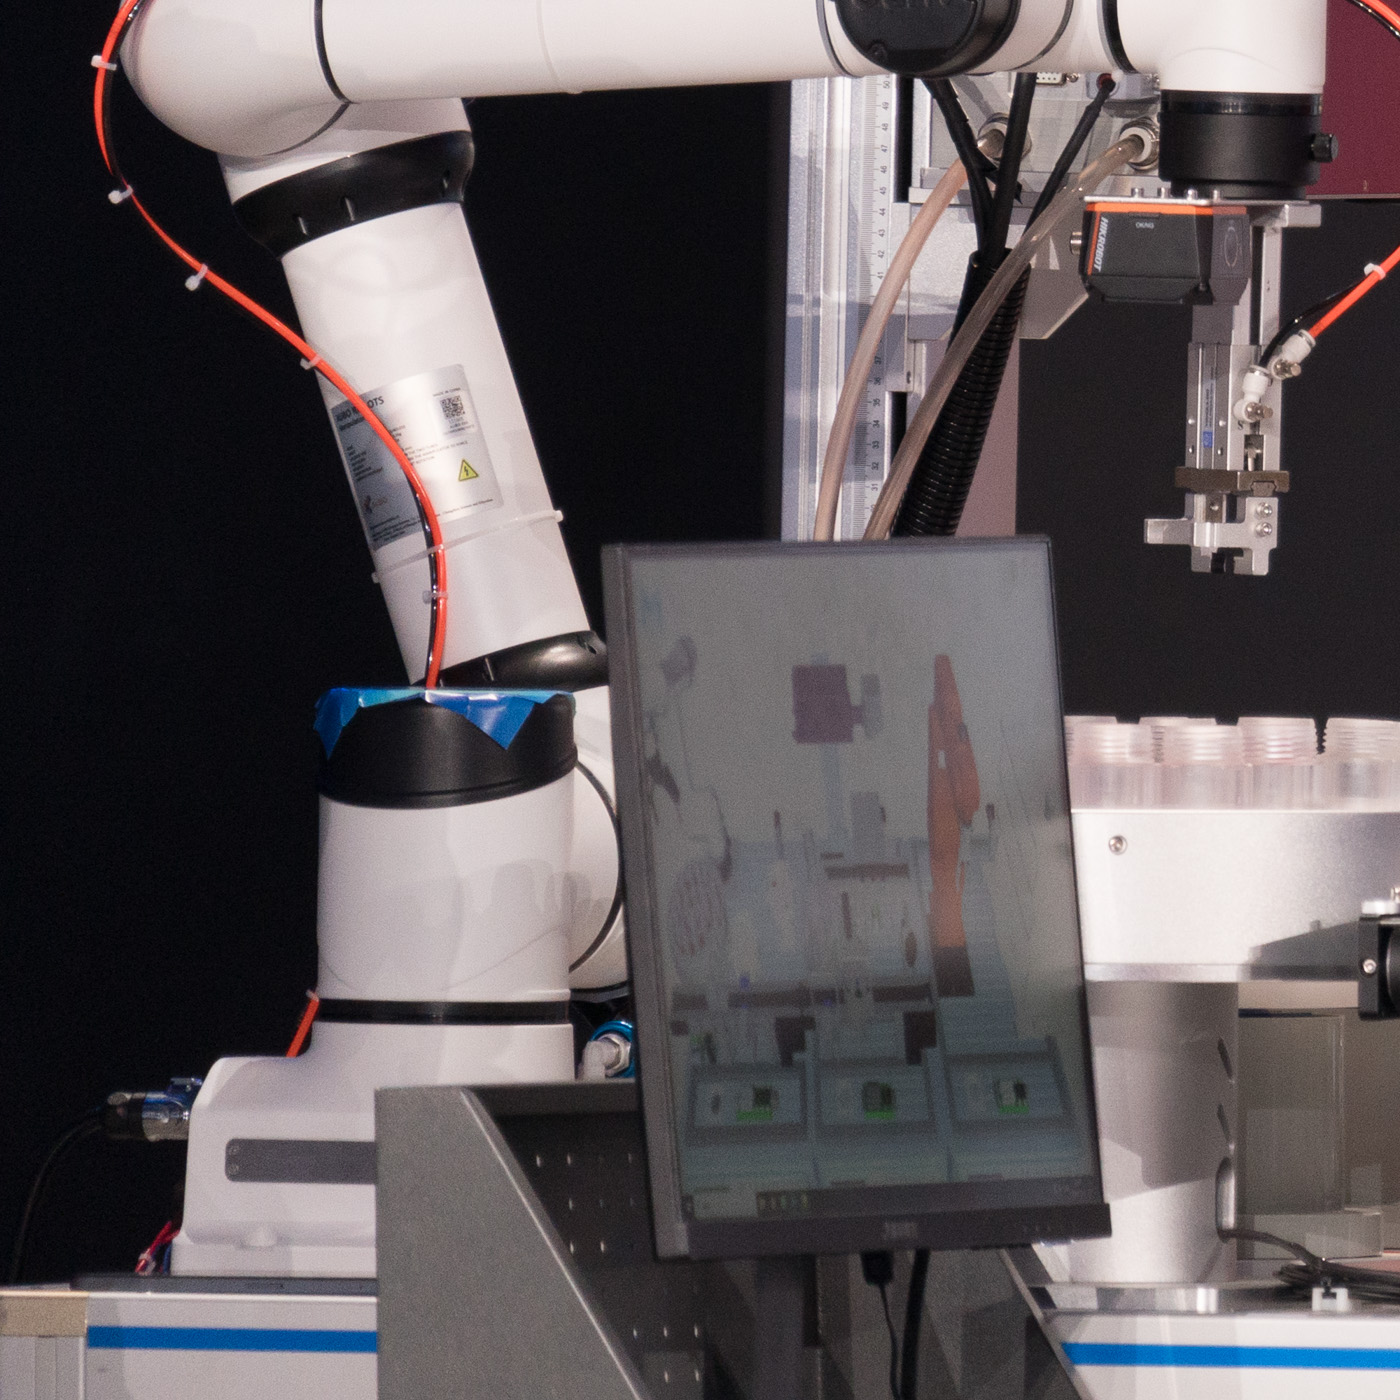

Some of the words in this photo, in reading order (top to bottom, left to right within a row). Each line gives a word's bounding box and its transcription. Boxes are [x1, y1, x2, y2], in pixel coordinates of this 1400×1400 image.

[882, 101, 890, 111] 49
[881, 122, 889, 132] 48
[881, 144, 889, 153] 47
[880, 165, 888, 174] 46
[879, 186, 887, 195] 45
[879, 207, 886, 217] 44
[878, 228, 886, 238] 43
[1093, 216, 1109, 273] HIKROBOT
[877, 249, 885, 259] 42
[877, 271, 884, 280] 41
[873, 397, 881, 407] 35
[872, 418, 880, 428] 34
[872, 440, 880, 449] 33
[871, 461, 879, 471] 32
[871, 482, 879, 491] 31
